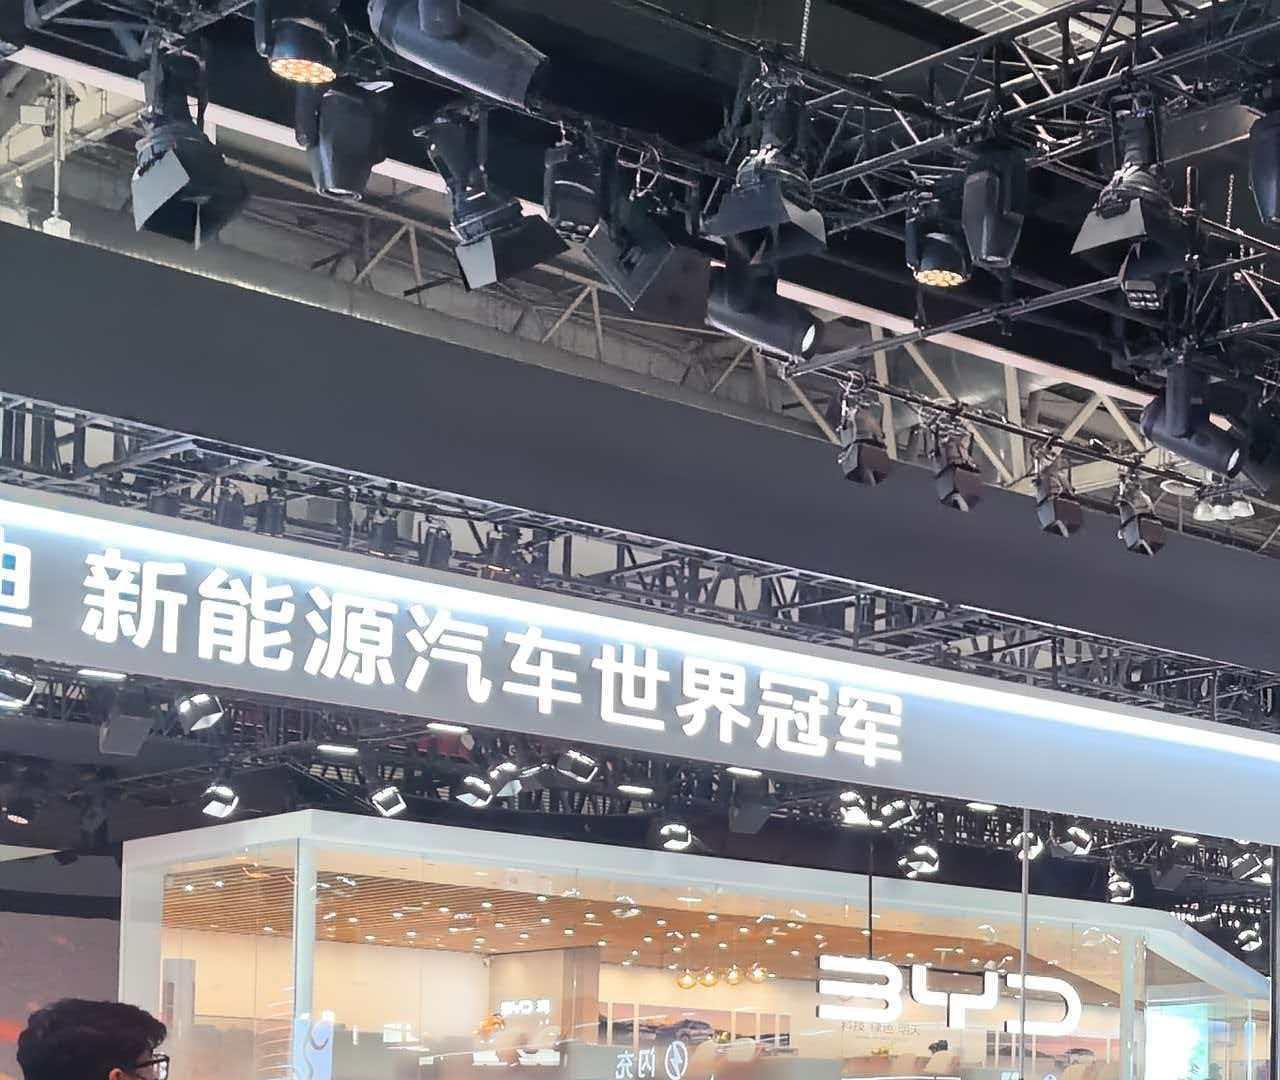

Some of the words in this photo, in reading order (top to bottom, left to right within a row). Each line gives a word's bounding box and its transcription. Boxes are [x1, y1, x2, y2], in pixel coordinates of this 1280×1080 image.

[81, 546, 903, 769] 新能源汽车世界冠军
[816, 954, 1082, 1037] BYD
